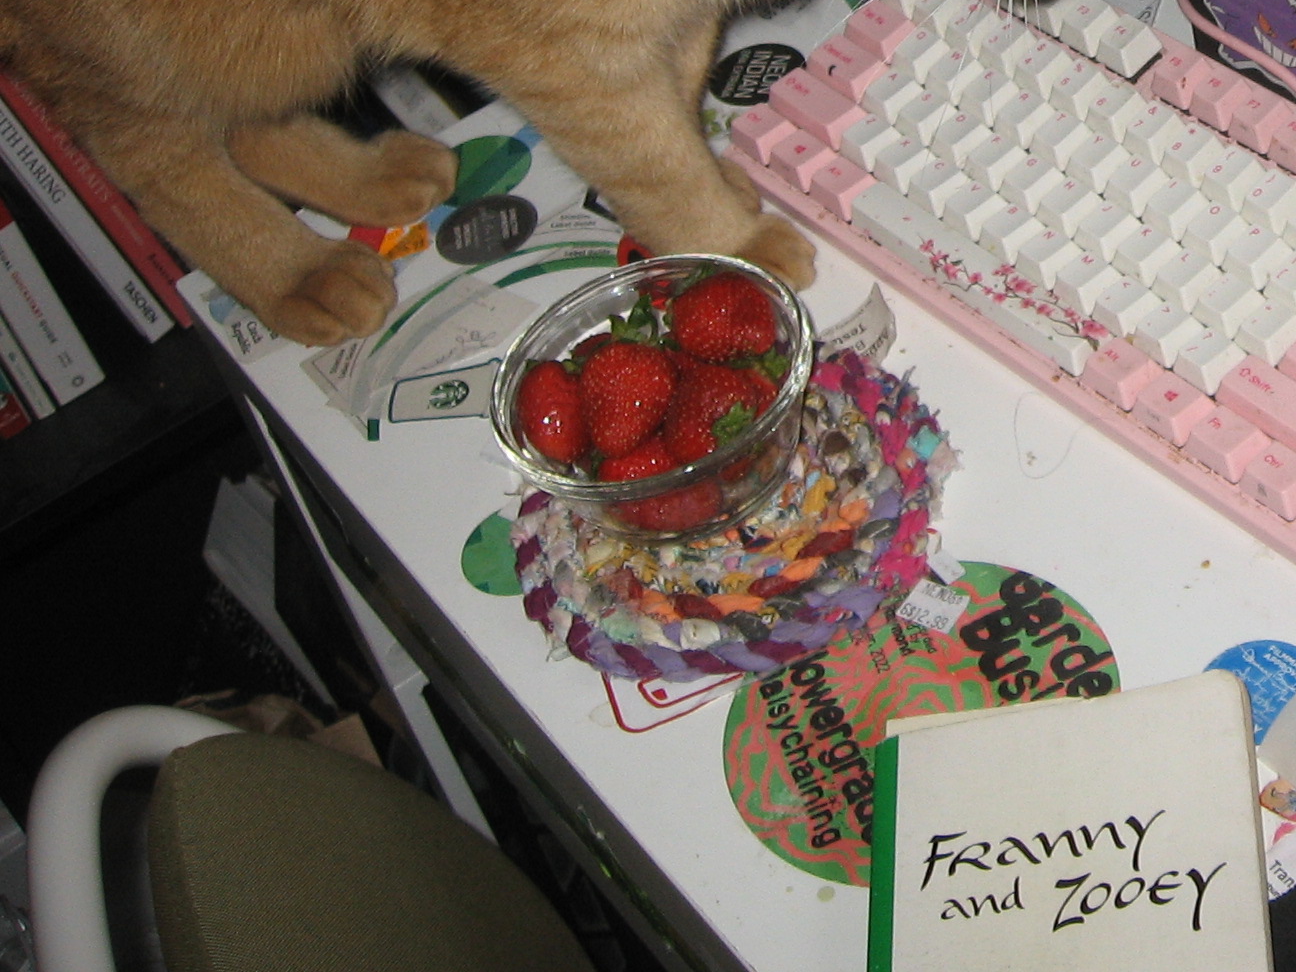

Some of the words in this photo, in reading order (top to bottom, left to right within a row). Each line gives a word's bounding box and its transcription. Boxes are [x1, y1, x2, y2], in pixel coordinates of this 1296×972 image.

[734, 49, 771, 100] INDIAN
[17, 143, 68, 206] HARING
[124, 280, 158, 325] TASCHEN
[1104, 350, 1119, 360] Alt
[1264, 454, 1284, 468] Ctrl
[939, 877, 1025, 923] and
